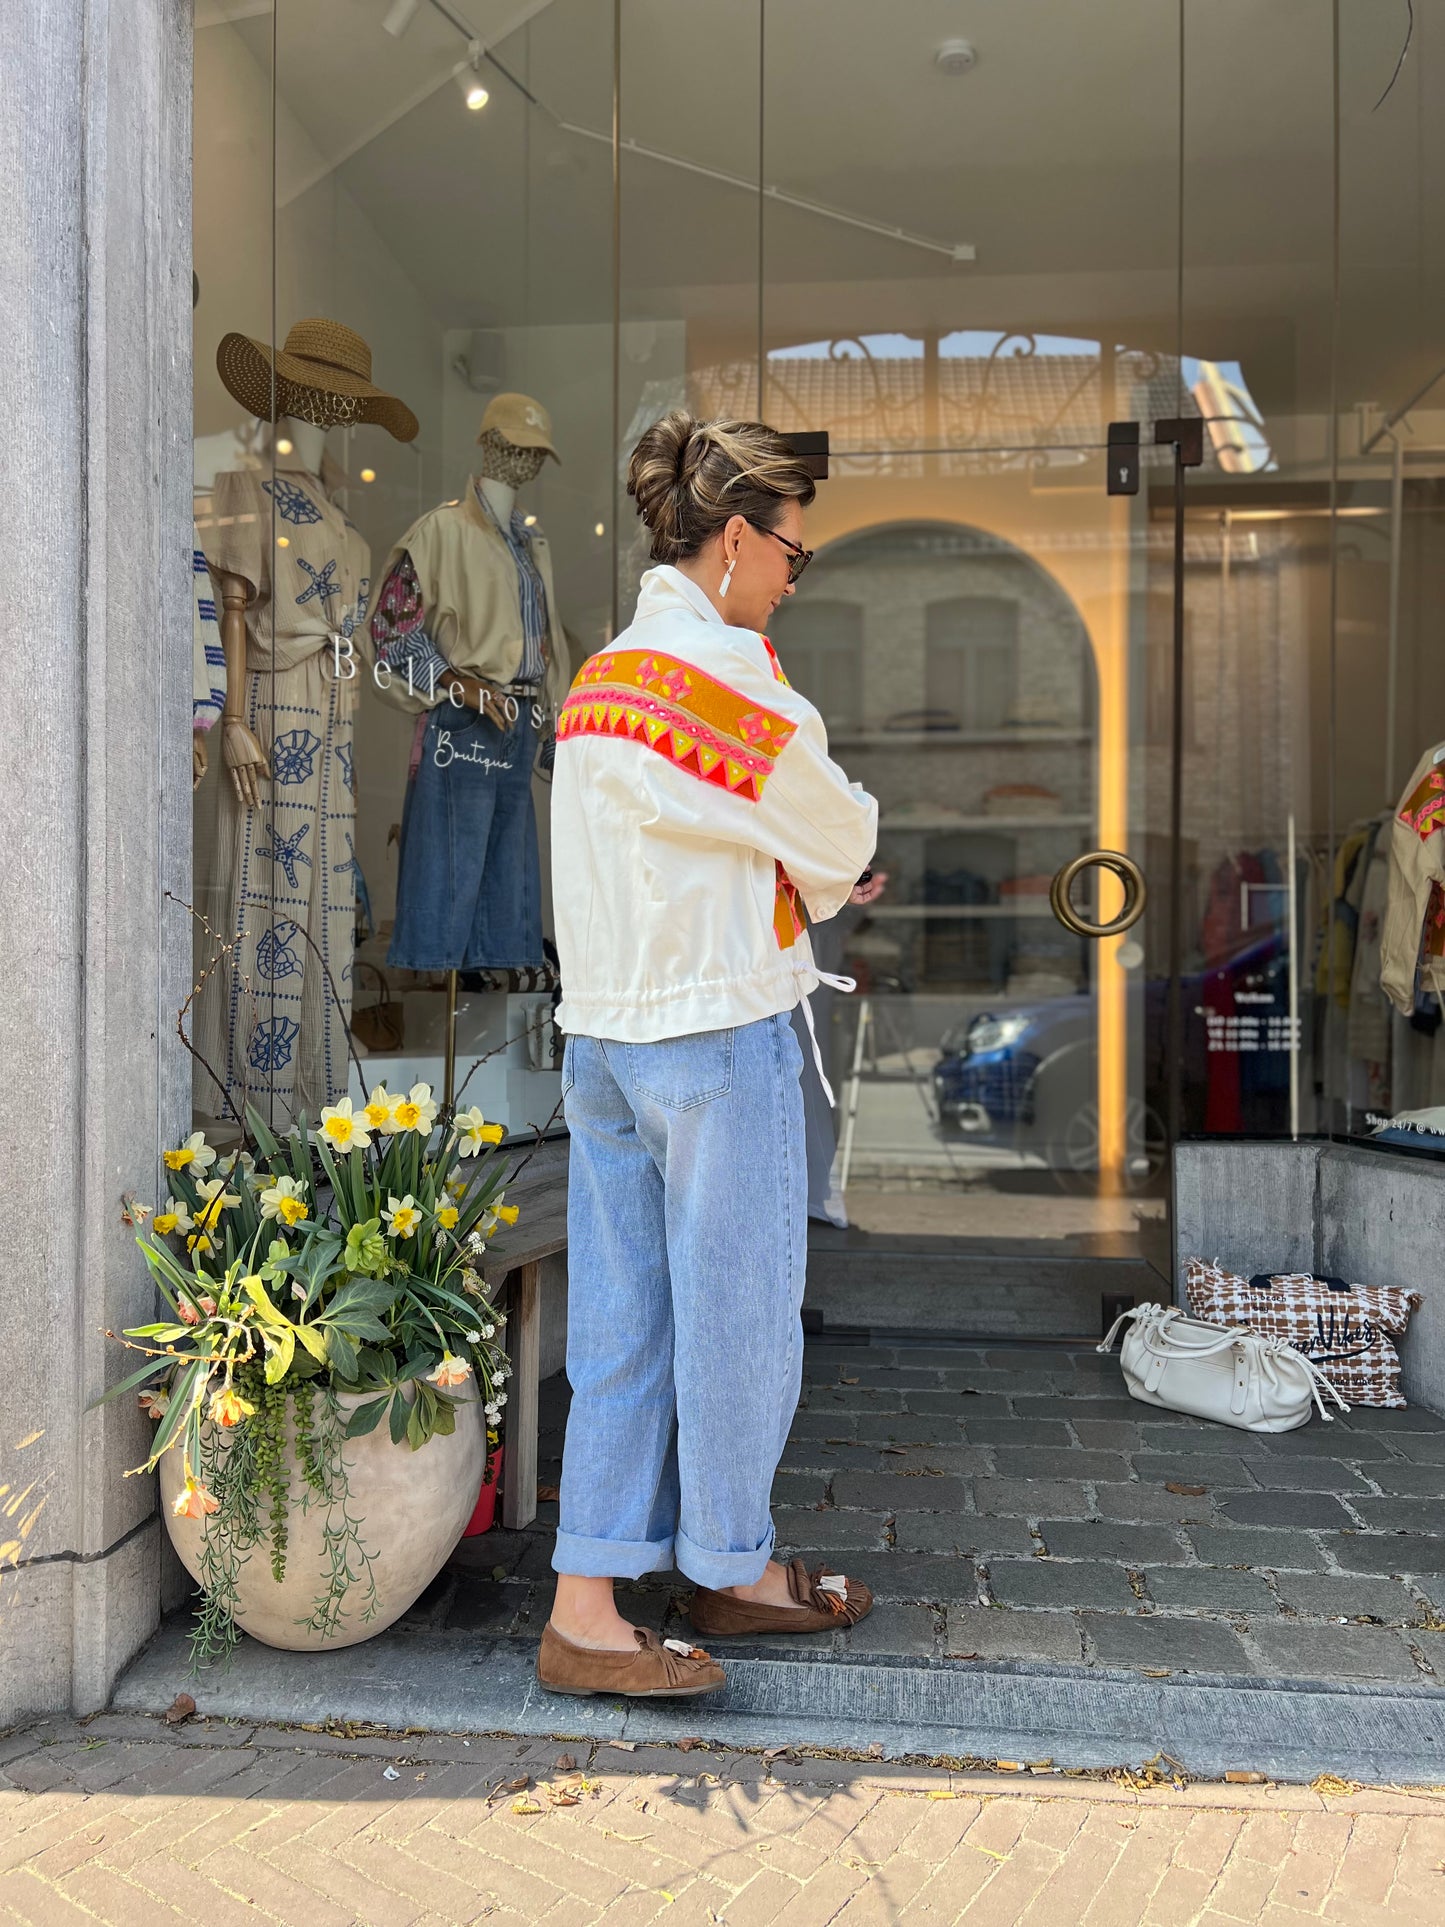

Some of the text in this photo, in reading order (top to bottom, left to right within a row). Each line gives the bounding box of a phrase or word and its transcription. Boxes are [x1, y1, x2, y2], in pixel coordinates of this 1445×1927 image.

[433, 729, 513, 776] Boutique
[1365, 1113, 1389, 1129] Shop
[1392, 1119, 1412, 1132] 24/7
[1416, 1122, 1426, 1135] @
[1238, 1292, 1287, 1302] This beach
[1316, 1304, 1377, 1351] Vibes
